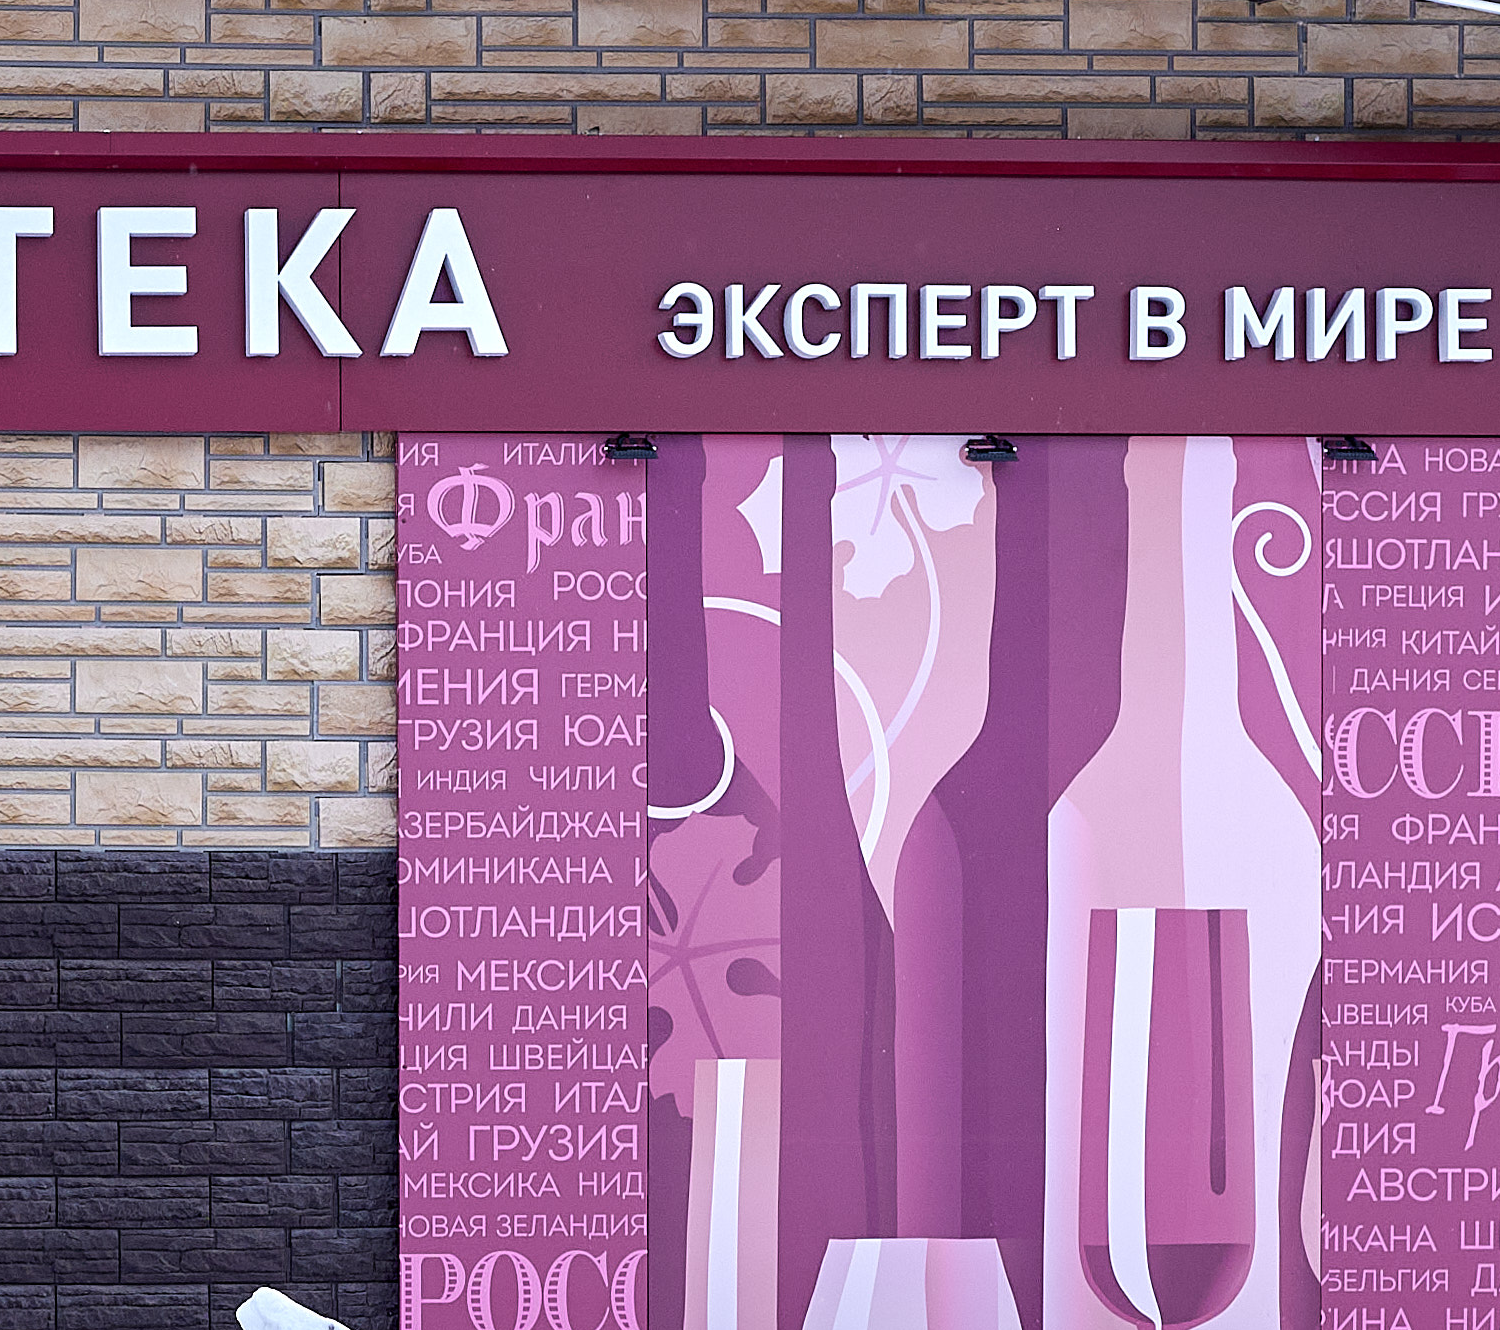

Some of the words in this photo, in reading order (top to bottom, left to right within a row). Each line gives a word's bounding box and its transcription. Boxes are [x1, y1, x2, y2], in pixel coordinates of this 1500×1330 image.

[656, 280, 1094, 363] ЭКСПЕРТ
[1128, 284, 1188, 361] В
[1224, 285, 1494, 363] МИРЕ
[1362, 585, 1464, 610] ГРЕЦИЯ
[397, 620, 591, 656] ФРАНЦИЯ
[1403, 625, 1500, 655] КИТАЙ
[1350, 669, 1451, 694] ДАНИЯ
[417, 770, 506, 793] ИНДИЯ
[529, 766, 615, 790] ЧИЛИ
[399, 805, 641, 842] ЗЕРБАЙДЖАН
[457, 960, 647, 991] МЕКСИКА
[512, 1005, 627, 1034] ДАНИЯ
[1446, 997, 1496, 1012] КУБА
[399, 1083, 526, 1113] СТРИЯ
[469, 1125, 638, 1161] ГРУЗИЯ
[1332, 1123, 1415, 1159] ДИЯ
[404, 1173, 561, 1198] МЕКСИКА
[579, 1172, 644, 1199] НИД
[497, 1214, 647, 1239] ЗЕЛАНДИЯ
